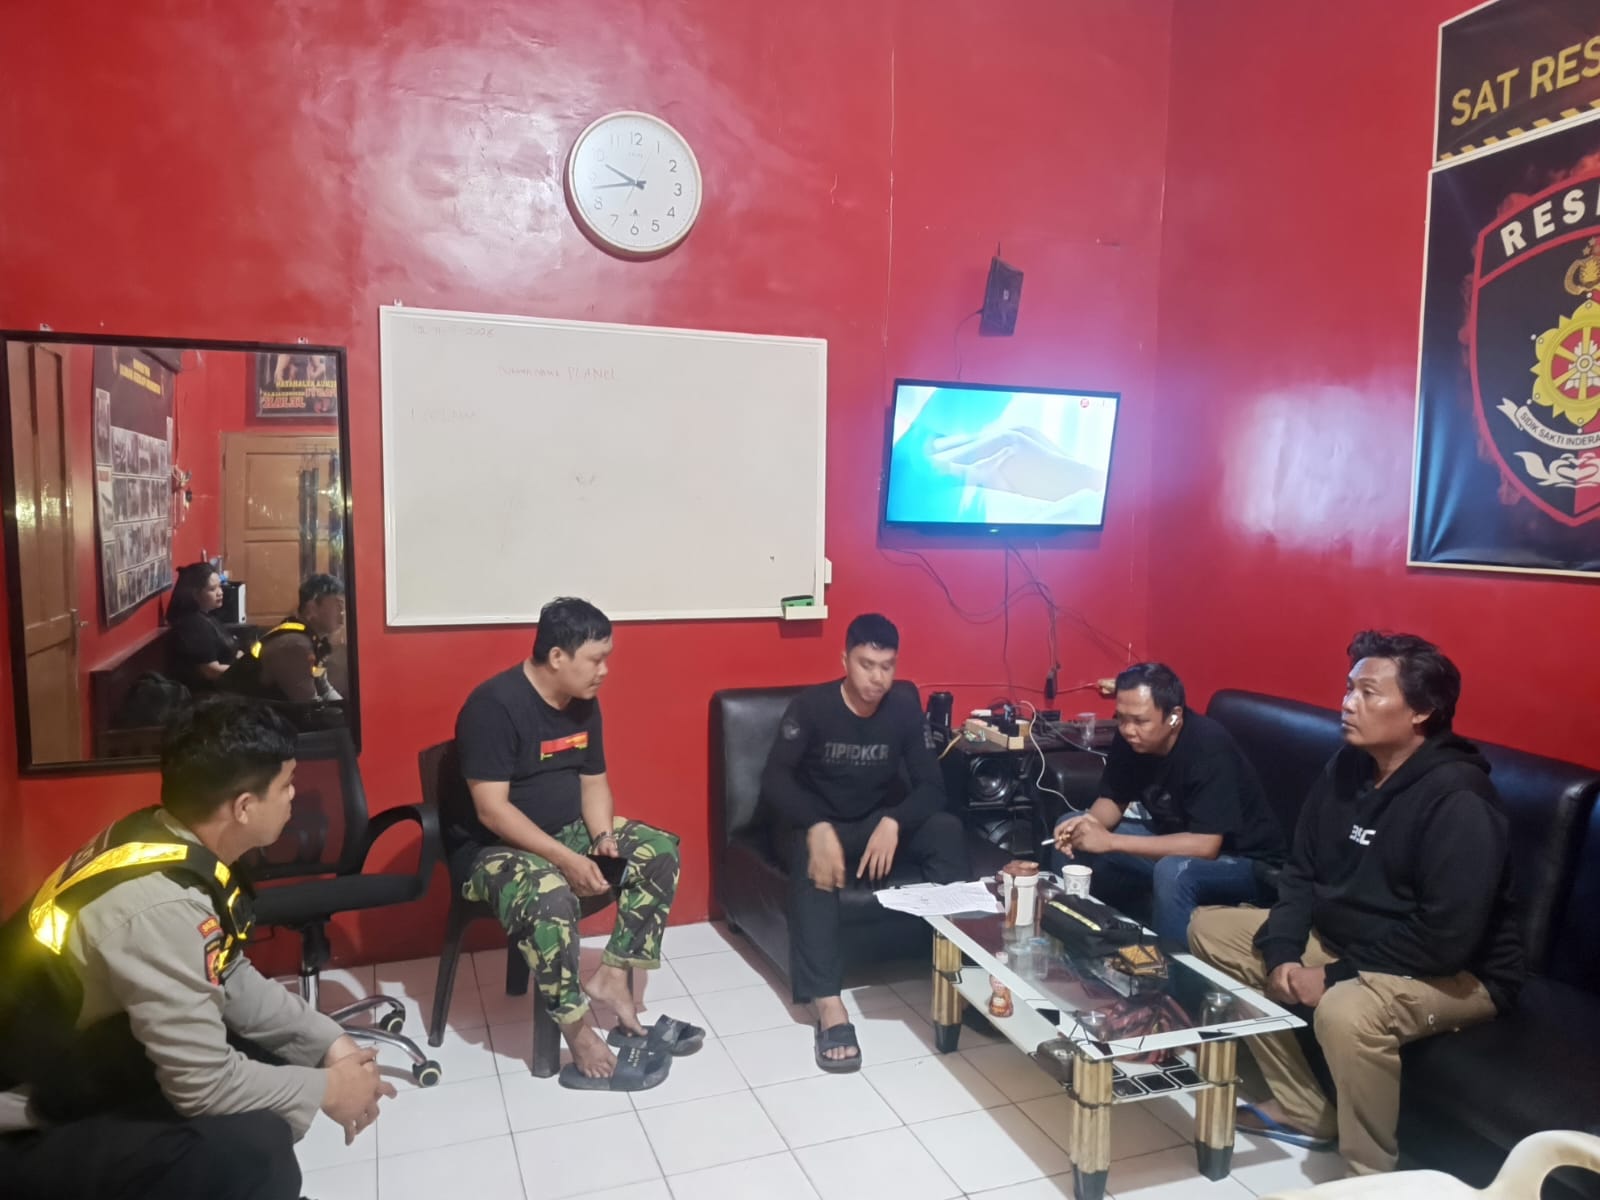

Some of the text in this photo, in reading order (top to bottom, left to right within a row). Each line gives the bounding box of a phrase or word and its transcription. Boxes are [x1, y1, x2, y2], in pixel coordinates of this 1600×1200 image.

[1451, 35, 1600, 127] SAT RES
[631, 132, 643, 146] 12
[669, 159, 677, 173] 2
[673, 183, 682, 197] 3
[667, 206, 675, 218] 4
[651, 219, 660, 232] 5
[1500, 184, 1600, 256] RES
[630, 224, 639, 236] 6
[1520, 412, 1537, 433] SIDIK
[1538, 428, 1565, 446] SAKTI
